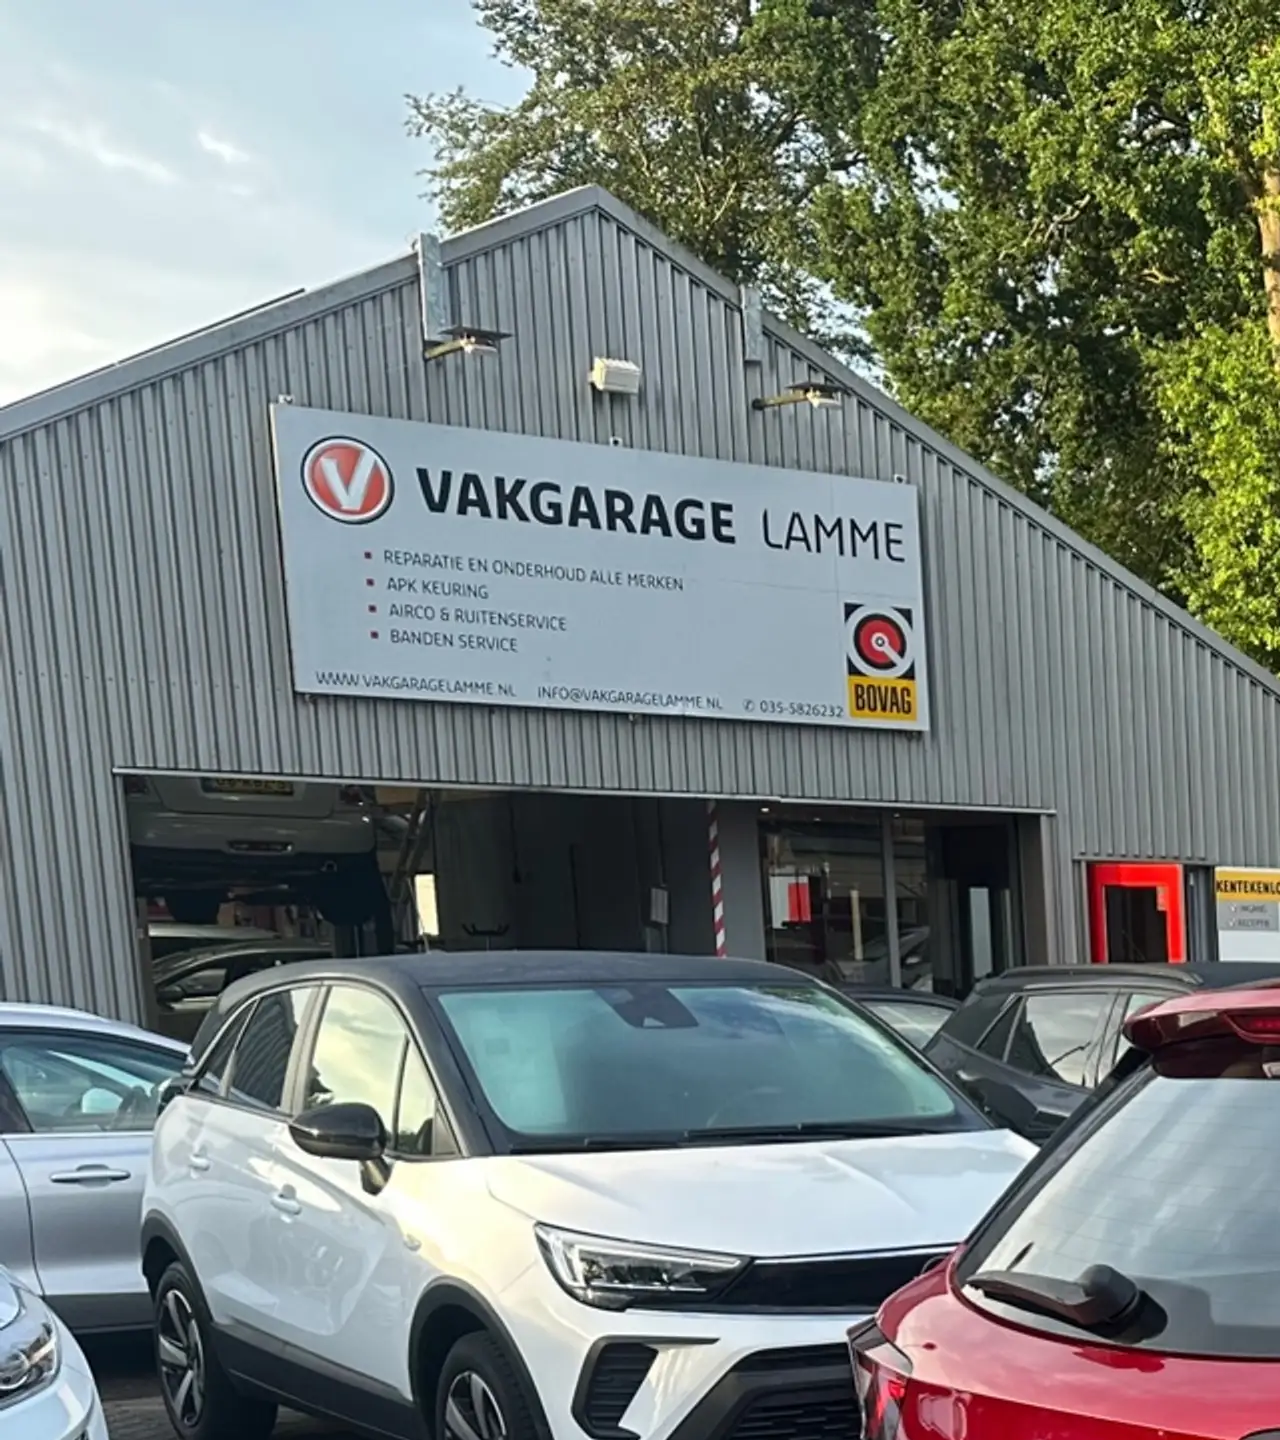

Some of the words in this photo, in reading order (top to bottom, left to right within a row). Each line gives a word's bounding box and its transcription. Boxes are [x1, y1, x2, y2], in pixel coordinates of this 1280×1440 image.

[416, 466, 736, 545] VAKGARAGE
[762, 509, 906, 563] LAMME
[383, 551, 463, 571] REPARATIE
[468, 557, 489, 574] EN
[492, 560, 586, 582] ONDERHOUD
[590, 568, 624, 585] ALLE
[627, 571, 684, 592] MERKEN
[387, 577, 417, 594] APK
[422, 580, 489, 600] KEURING
[388, 604, 436, 622] AIRCO
[439, 607, 450, 622] &
[454, 609, 567, 632] RUITENSERVICE
[390, 630, 454, 649] BANDEN
[458, 635, 519, 653] SERVICE
[316, 671, 516, 698] WWW.VAKGARAGELAMME.NL
[538, 686, 723, 710] INFO@VAKGARAGELAMME.NL
[759, 699, 844, 719] 035-5826232
[854, 682, 913, 715] BOVAG
